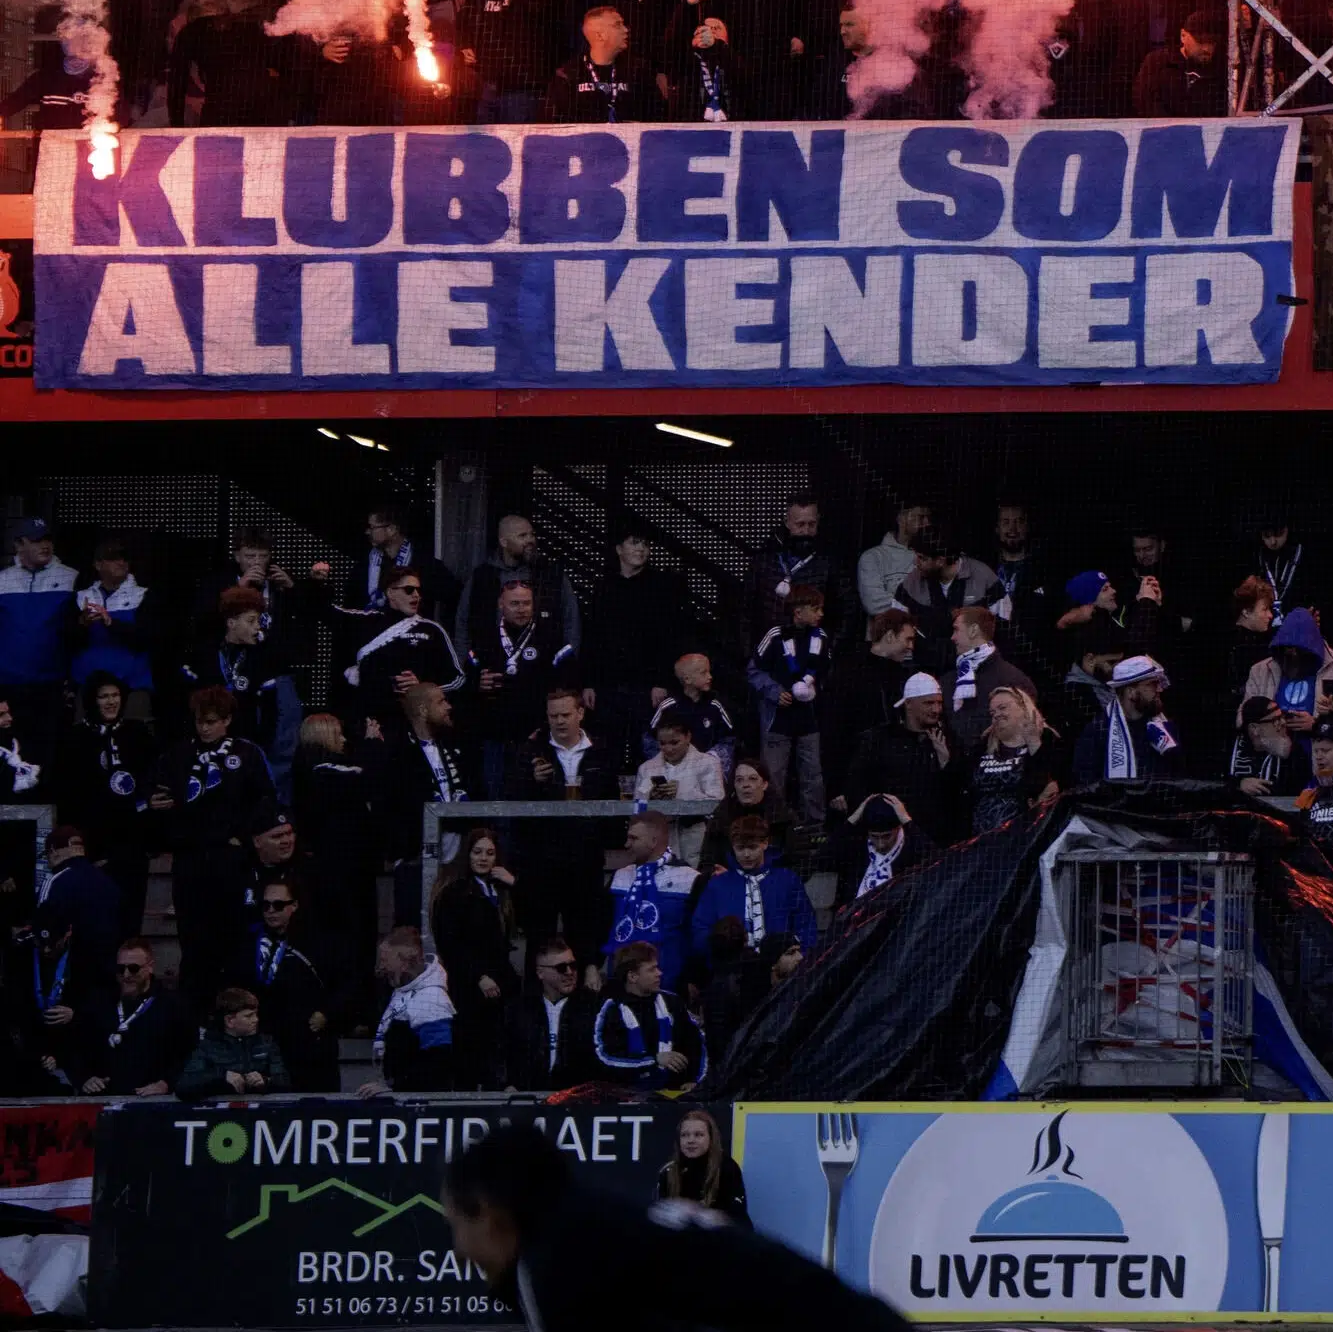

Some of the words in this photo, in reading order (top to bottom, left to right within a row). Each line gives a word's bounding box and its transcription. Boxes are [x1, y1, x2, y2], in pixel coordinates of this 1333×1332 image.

[73, 129, 846, 247] KLUBBEN
[896, 125, 1289, 242] SOM
[76, 259, 496, 377] ALLE
[554, 252, 1268, 371] KENDER
[298, 1250, 405, 1283] BRDR.
[416, 1250, 489, 1282] SAN
[909, 1253, 1186, 1300] LIVRETTEN
[296, 1297, 316, 1315] 51
[321, 1297, 342, 1314] 51
[349, 1296, 372, 1314] 06
[376, 1296, 398, 1313] 73
[413, 1296, 434, 1313] 51
[440, 1296, 461, 1313] 51
[466, 1295, 489, 1312] 05
